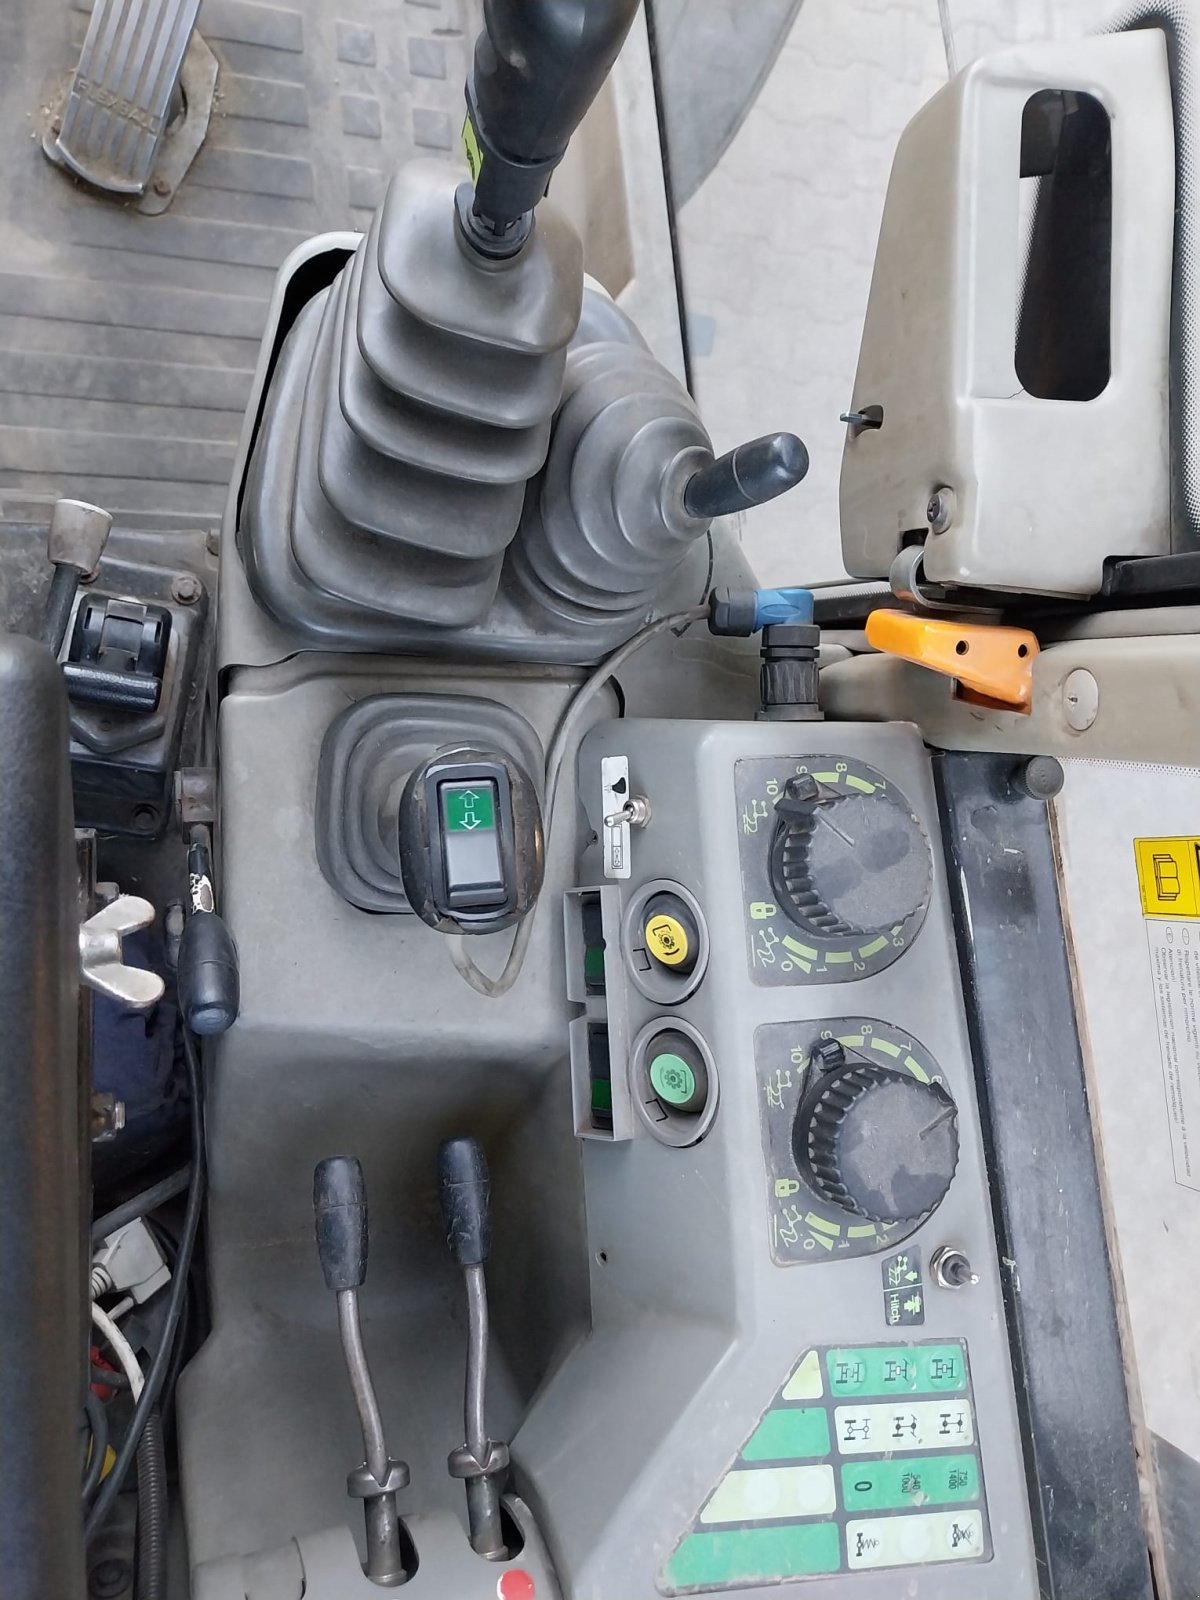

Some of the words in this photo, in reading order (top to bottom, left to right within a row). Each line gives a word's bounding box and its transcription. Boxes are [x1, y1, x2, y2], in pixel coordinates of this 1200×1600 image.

[835, 762, 848, 773] 8
[766, 778, 778, 795] 10
[874, 779, 887, 791] 7
[892, 937, 904, 948] 3
[780, 960, 794, 972] 0
[853, 962, 866, 972] 2
[820, 1030, 833, 1040] 9
[860, 1024, 873, 1035] 8
[899, 1041, 912, 1052] 7
[790, 1045, 803, 1063] 10
[803, 1238, 816, 1250] 0
[838, 1238, 850, 1249] 1
[875, 1233, 890, 1245] 2
[890, 1293, 900, 1323] Hitch
[948, 1469, 957, 1490] 1400
[959, 1470, 967, 1487] 750
[854, 1481, 872, 1492] 0
